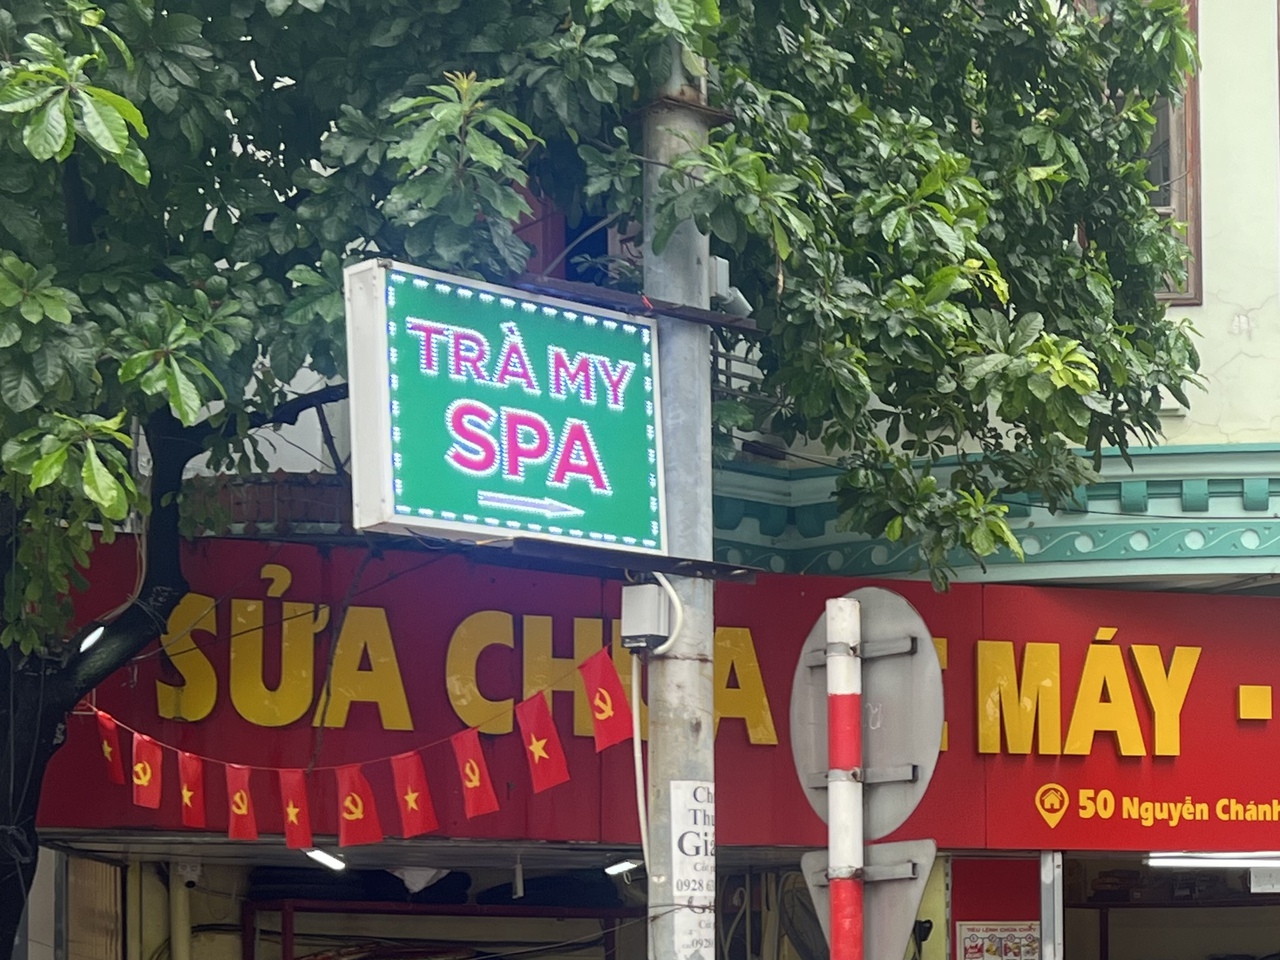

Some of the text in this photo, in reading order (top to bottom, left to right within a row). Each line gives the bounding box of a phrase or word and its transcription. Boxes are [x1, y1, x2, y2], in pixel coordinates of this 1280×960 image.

[405, 316, 637, 411] TRÀ MY
[444, 398, 614, 496] SPA
[156, 564, 414, 731] SỬA
[446, 610, 778, 745] CHA
[977, 627, 1202, 756] MÁY
[693, 786, 714, 804] Ch
[1078, 789, 1115, 819] 50
[1122, 796, 1209, 827] Nguyễn
[676, 878, 704, 891] 0928
